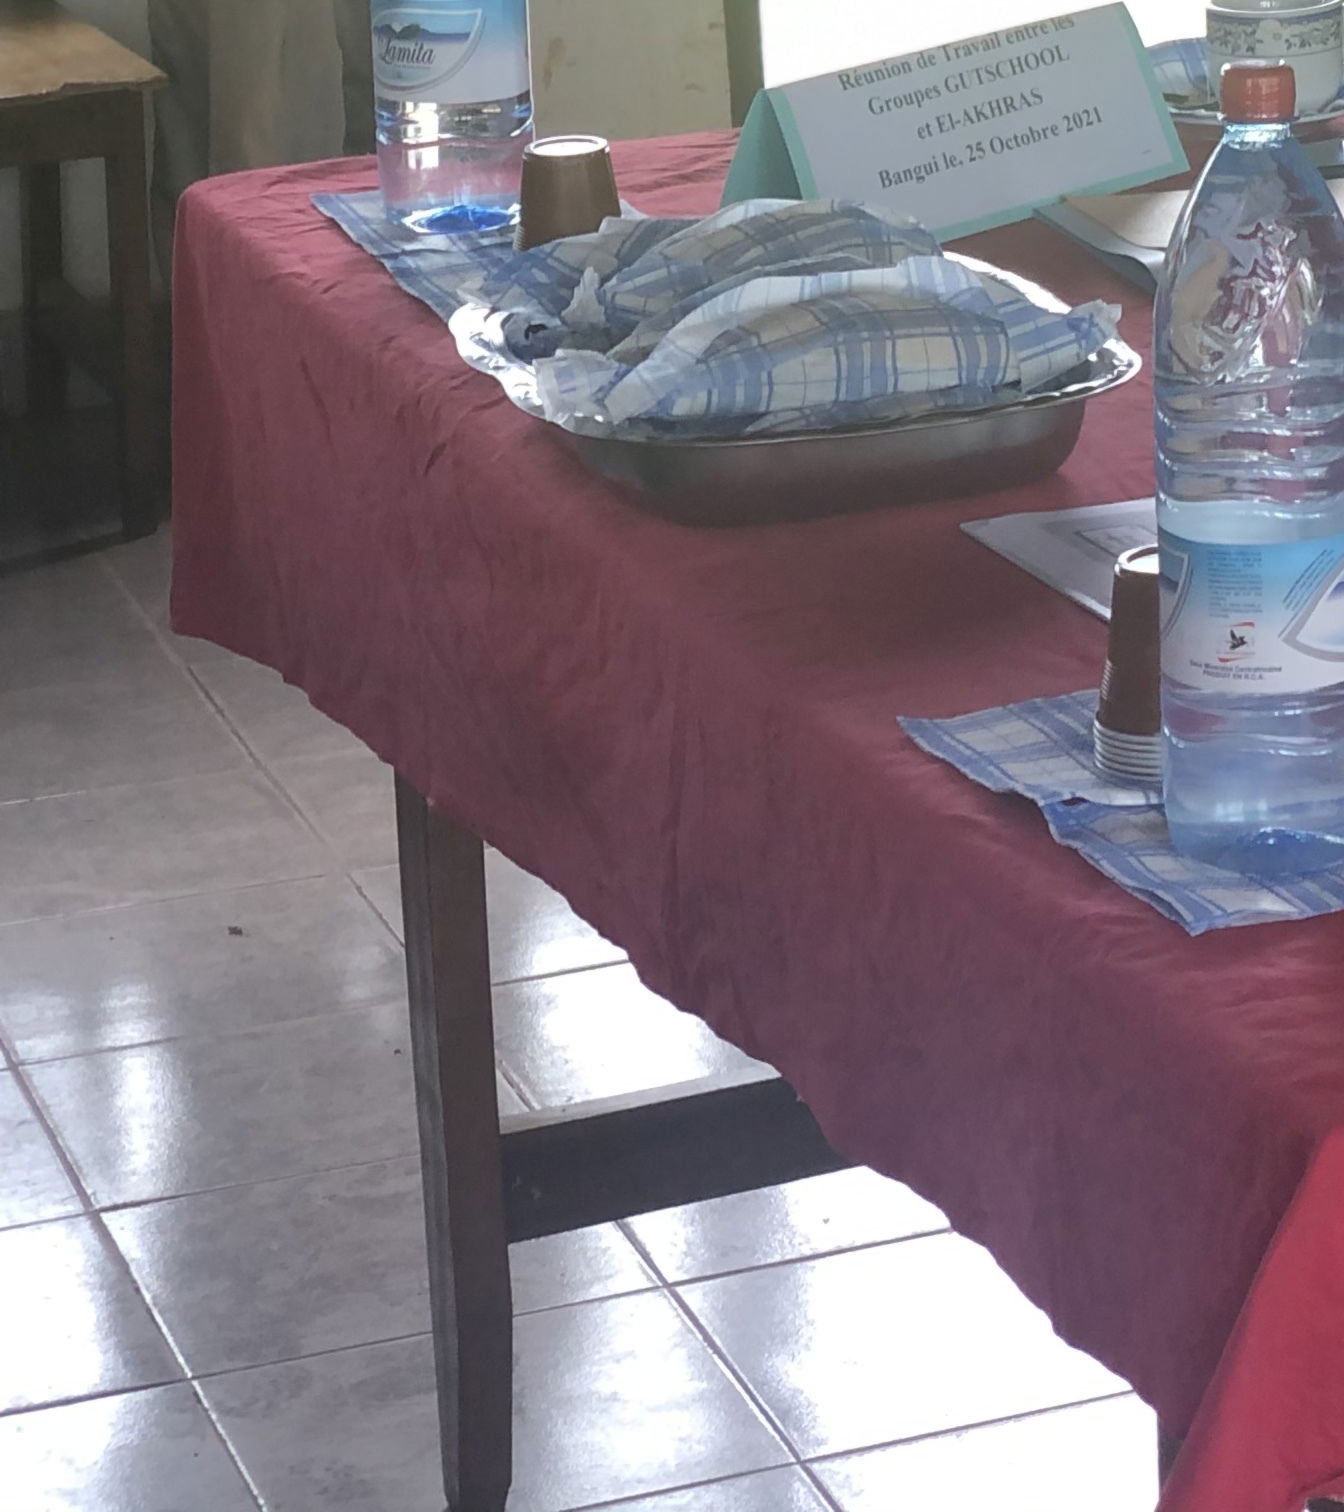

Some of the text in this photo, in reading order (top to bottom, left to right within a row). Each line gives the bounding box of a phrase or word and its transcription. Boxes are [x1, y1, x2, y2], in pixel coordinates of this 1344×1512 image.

[838, 15, 1075, 90] Réunion de Travail entre les
[868, 44, 1070, 116] Groupes GUTSCHOOL
[878, 155, 940, 189] Bangui
[965, 141, 986, 163] 25
[990, 124, 1060, 155] Octobre
[1062, 106, 1103, 133] 2021
[917, 87, 1044, 139] et El-AKHRAS
